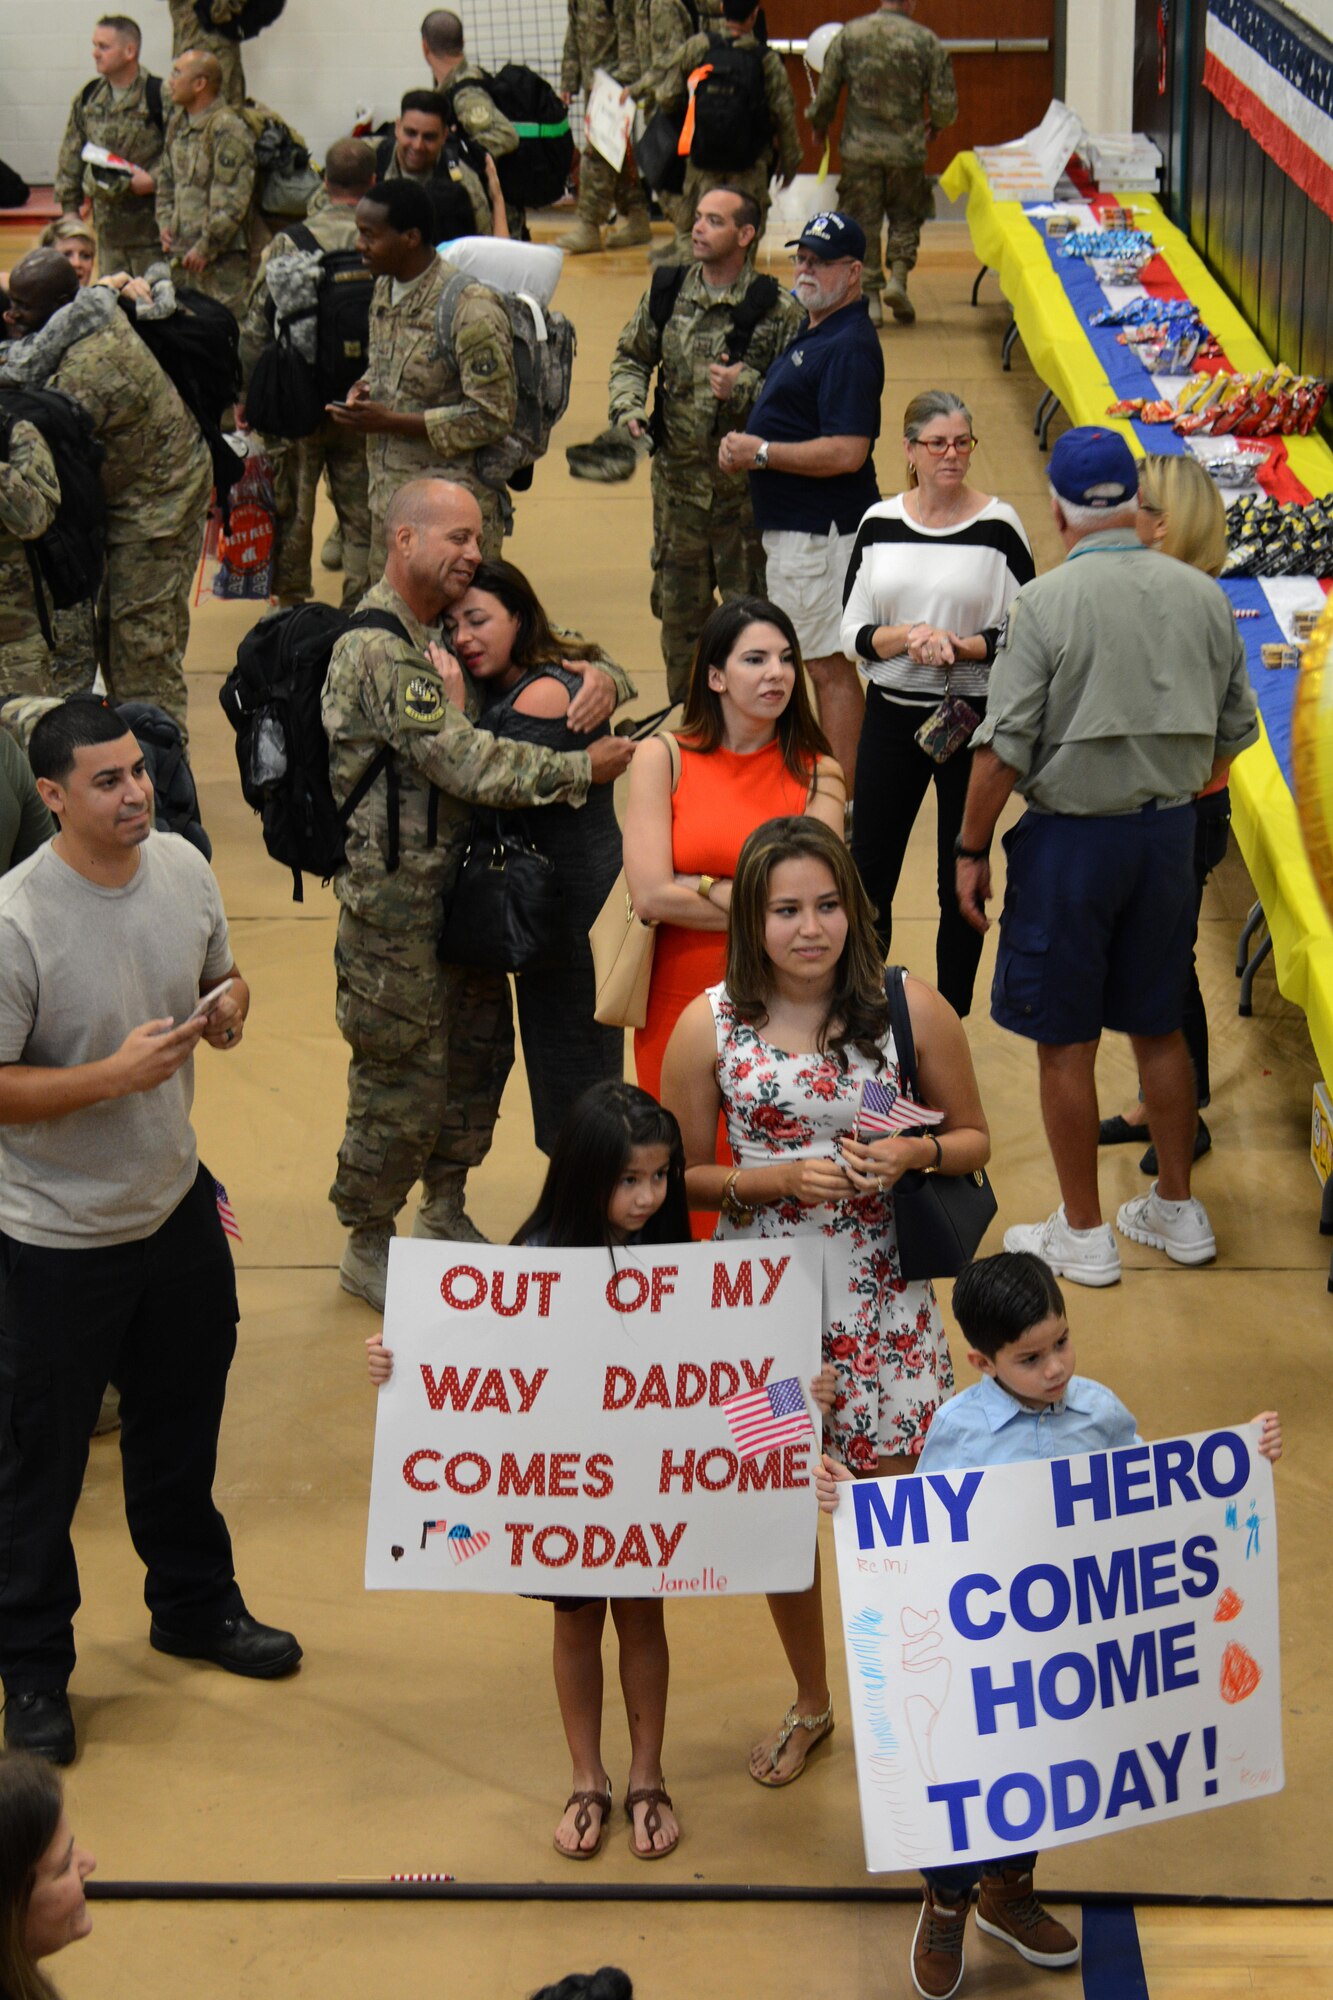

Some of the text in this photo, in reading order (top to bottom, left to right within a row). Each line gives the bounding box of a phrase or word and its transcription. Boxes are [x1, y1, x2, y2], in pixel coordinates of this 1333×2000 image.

[440, 1256, 791, 1317] OUT OF MY
[420, 1357, 775, 1414] WAY DADDY
[402, 1442, 812, 1499] COMES HOME
[851, 1431, 1251, 1551] MY HERO
[505, 1522, 688, 1569] TODAY
[652, 1567, 728, 1593] Janelle
[948, 1534, 1220, 1641] COMES
[970, 1620, 1201, 1736] HOME
[926, 1724, 1219, 1852] TODAY!
